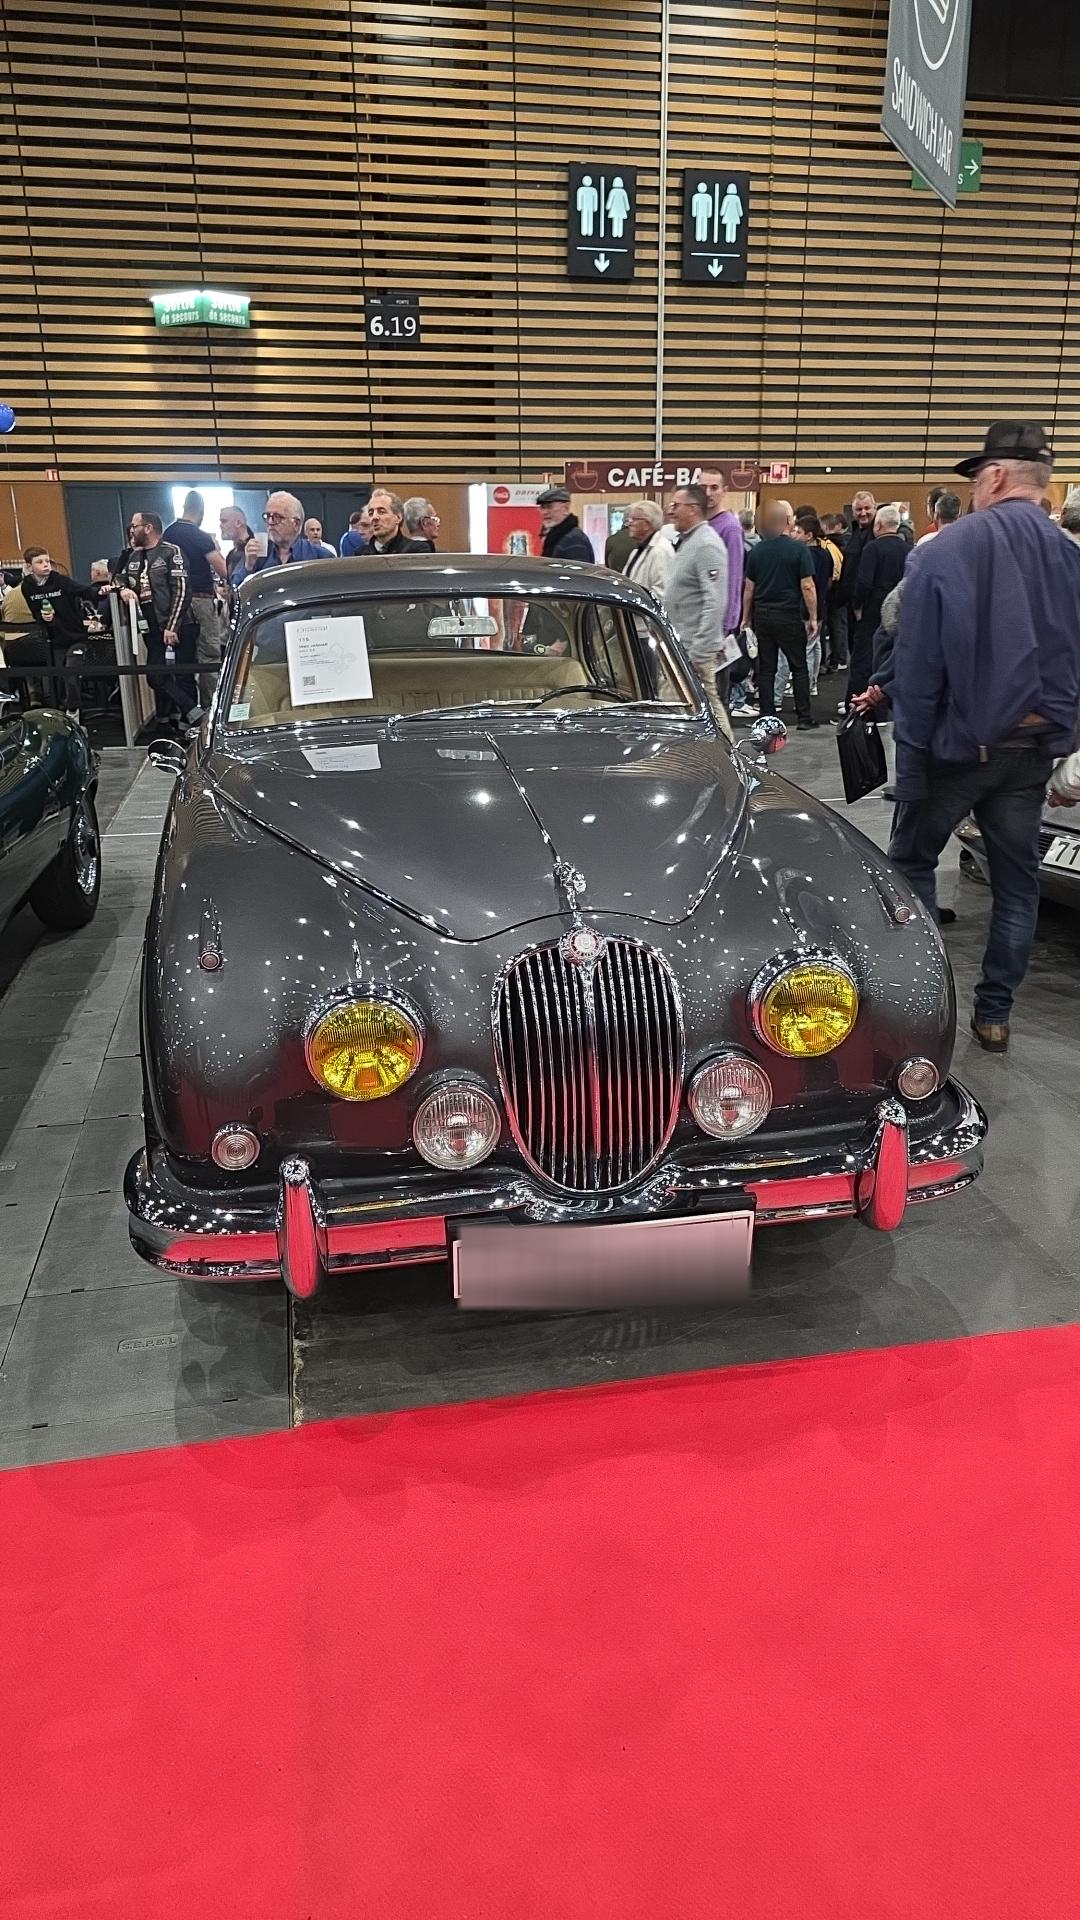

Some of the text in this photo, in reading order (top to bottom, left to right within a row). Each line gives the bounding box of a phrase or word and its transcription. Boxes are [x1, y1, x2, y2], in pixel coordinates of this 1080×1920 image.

[891, 56, 953, 177] SANDWICH BAR
[161, 310, 200, 325] de secours
[208, 310, 246, 325] de secours
[370, 315, 417, 337] 6.19
[607, 463, 702, 488] CAFÉ-BA
